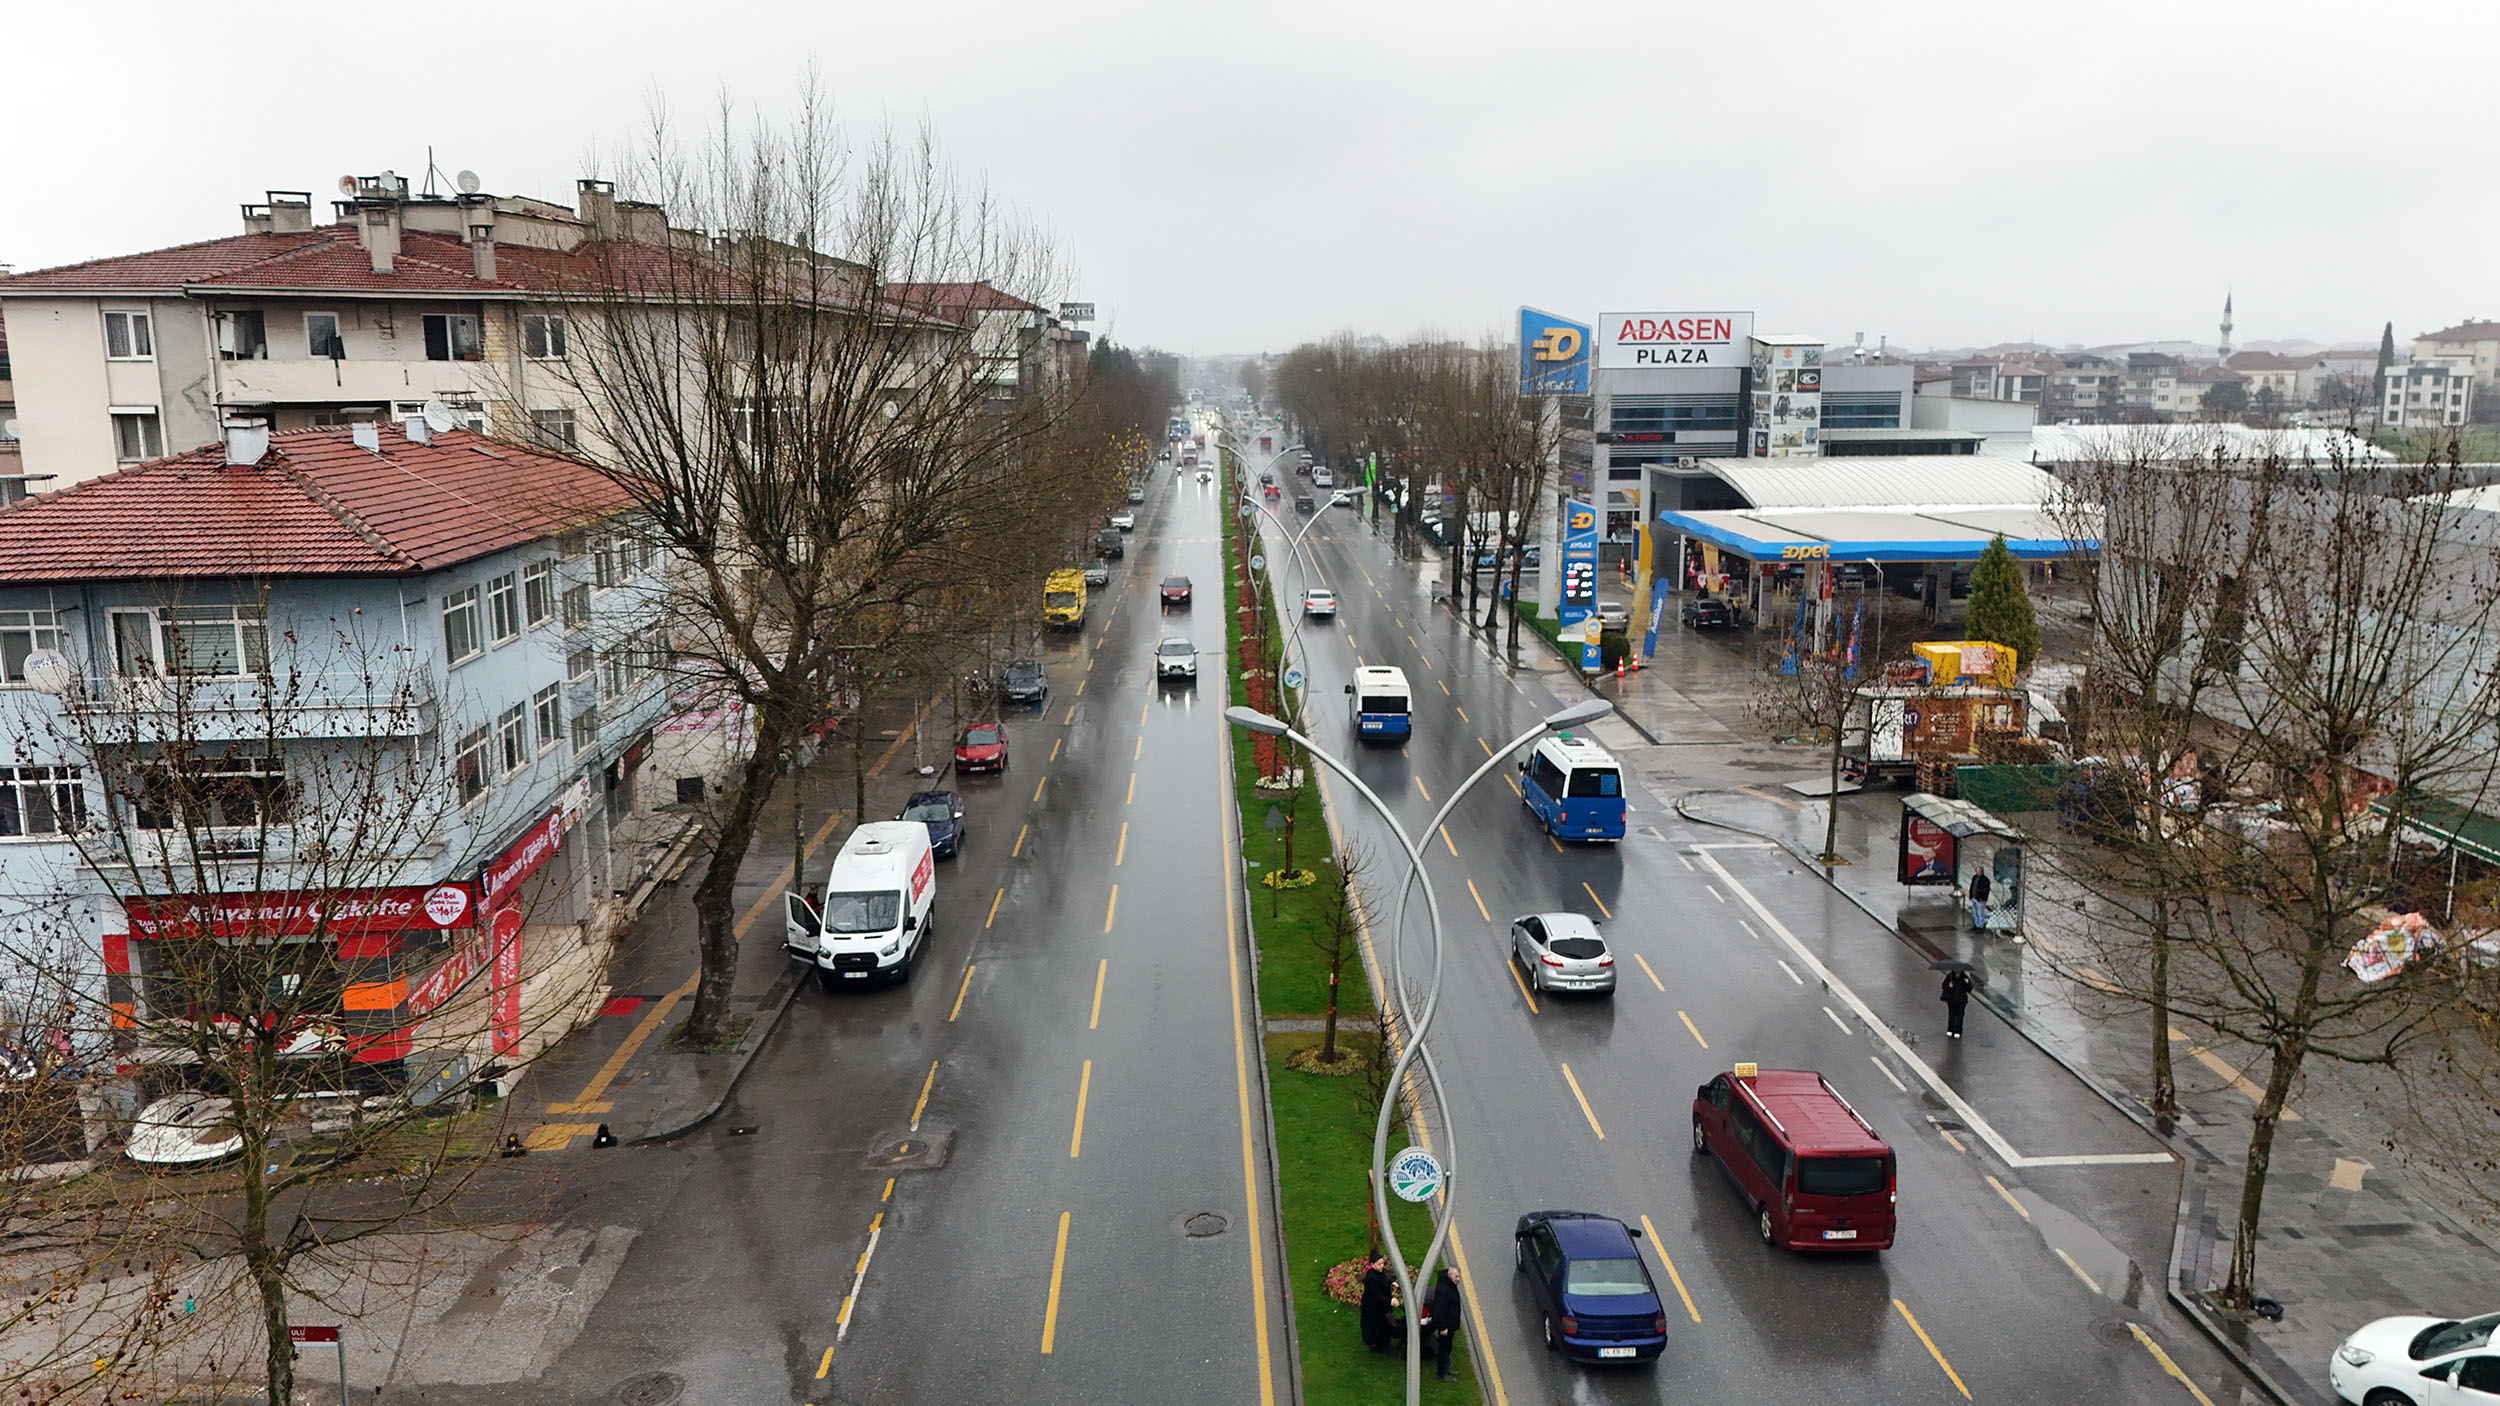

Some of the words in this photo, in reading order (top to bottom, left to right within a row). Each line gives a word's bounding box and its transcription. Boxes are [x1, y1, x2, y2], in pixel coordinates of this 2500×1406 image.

[1061, 307, 1094, 317] HOTEL
[1618, 319, 1731, 341] ADASEN
[1637, 349, 1708, 363] PLAZA
